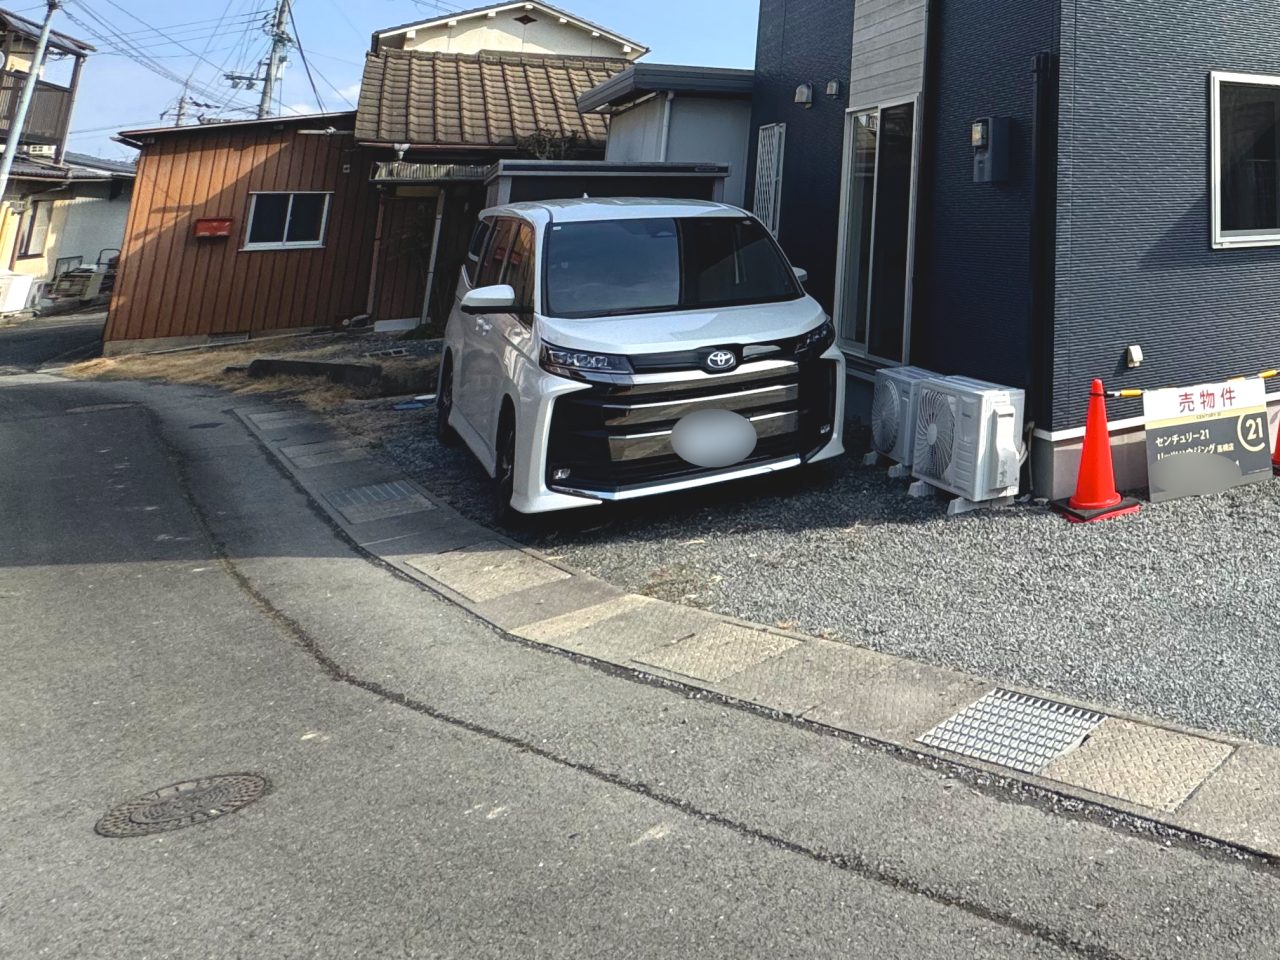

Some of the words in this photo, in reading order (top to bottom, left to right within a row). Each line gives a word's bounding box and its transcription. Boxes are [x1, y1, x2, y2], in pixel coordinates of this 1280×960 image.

[1179, 387, 1236, 413] 売物件
[1155, 429, 1210, 447] センチュリー21
